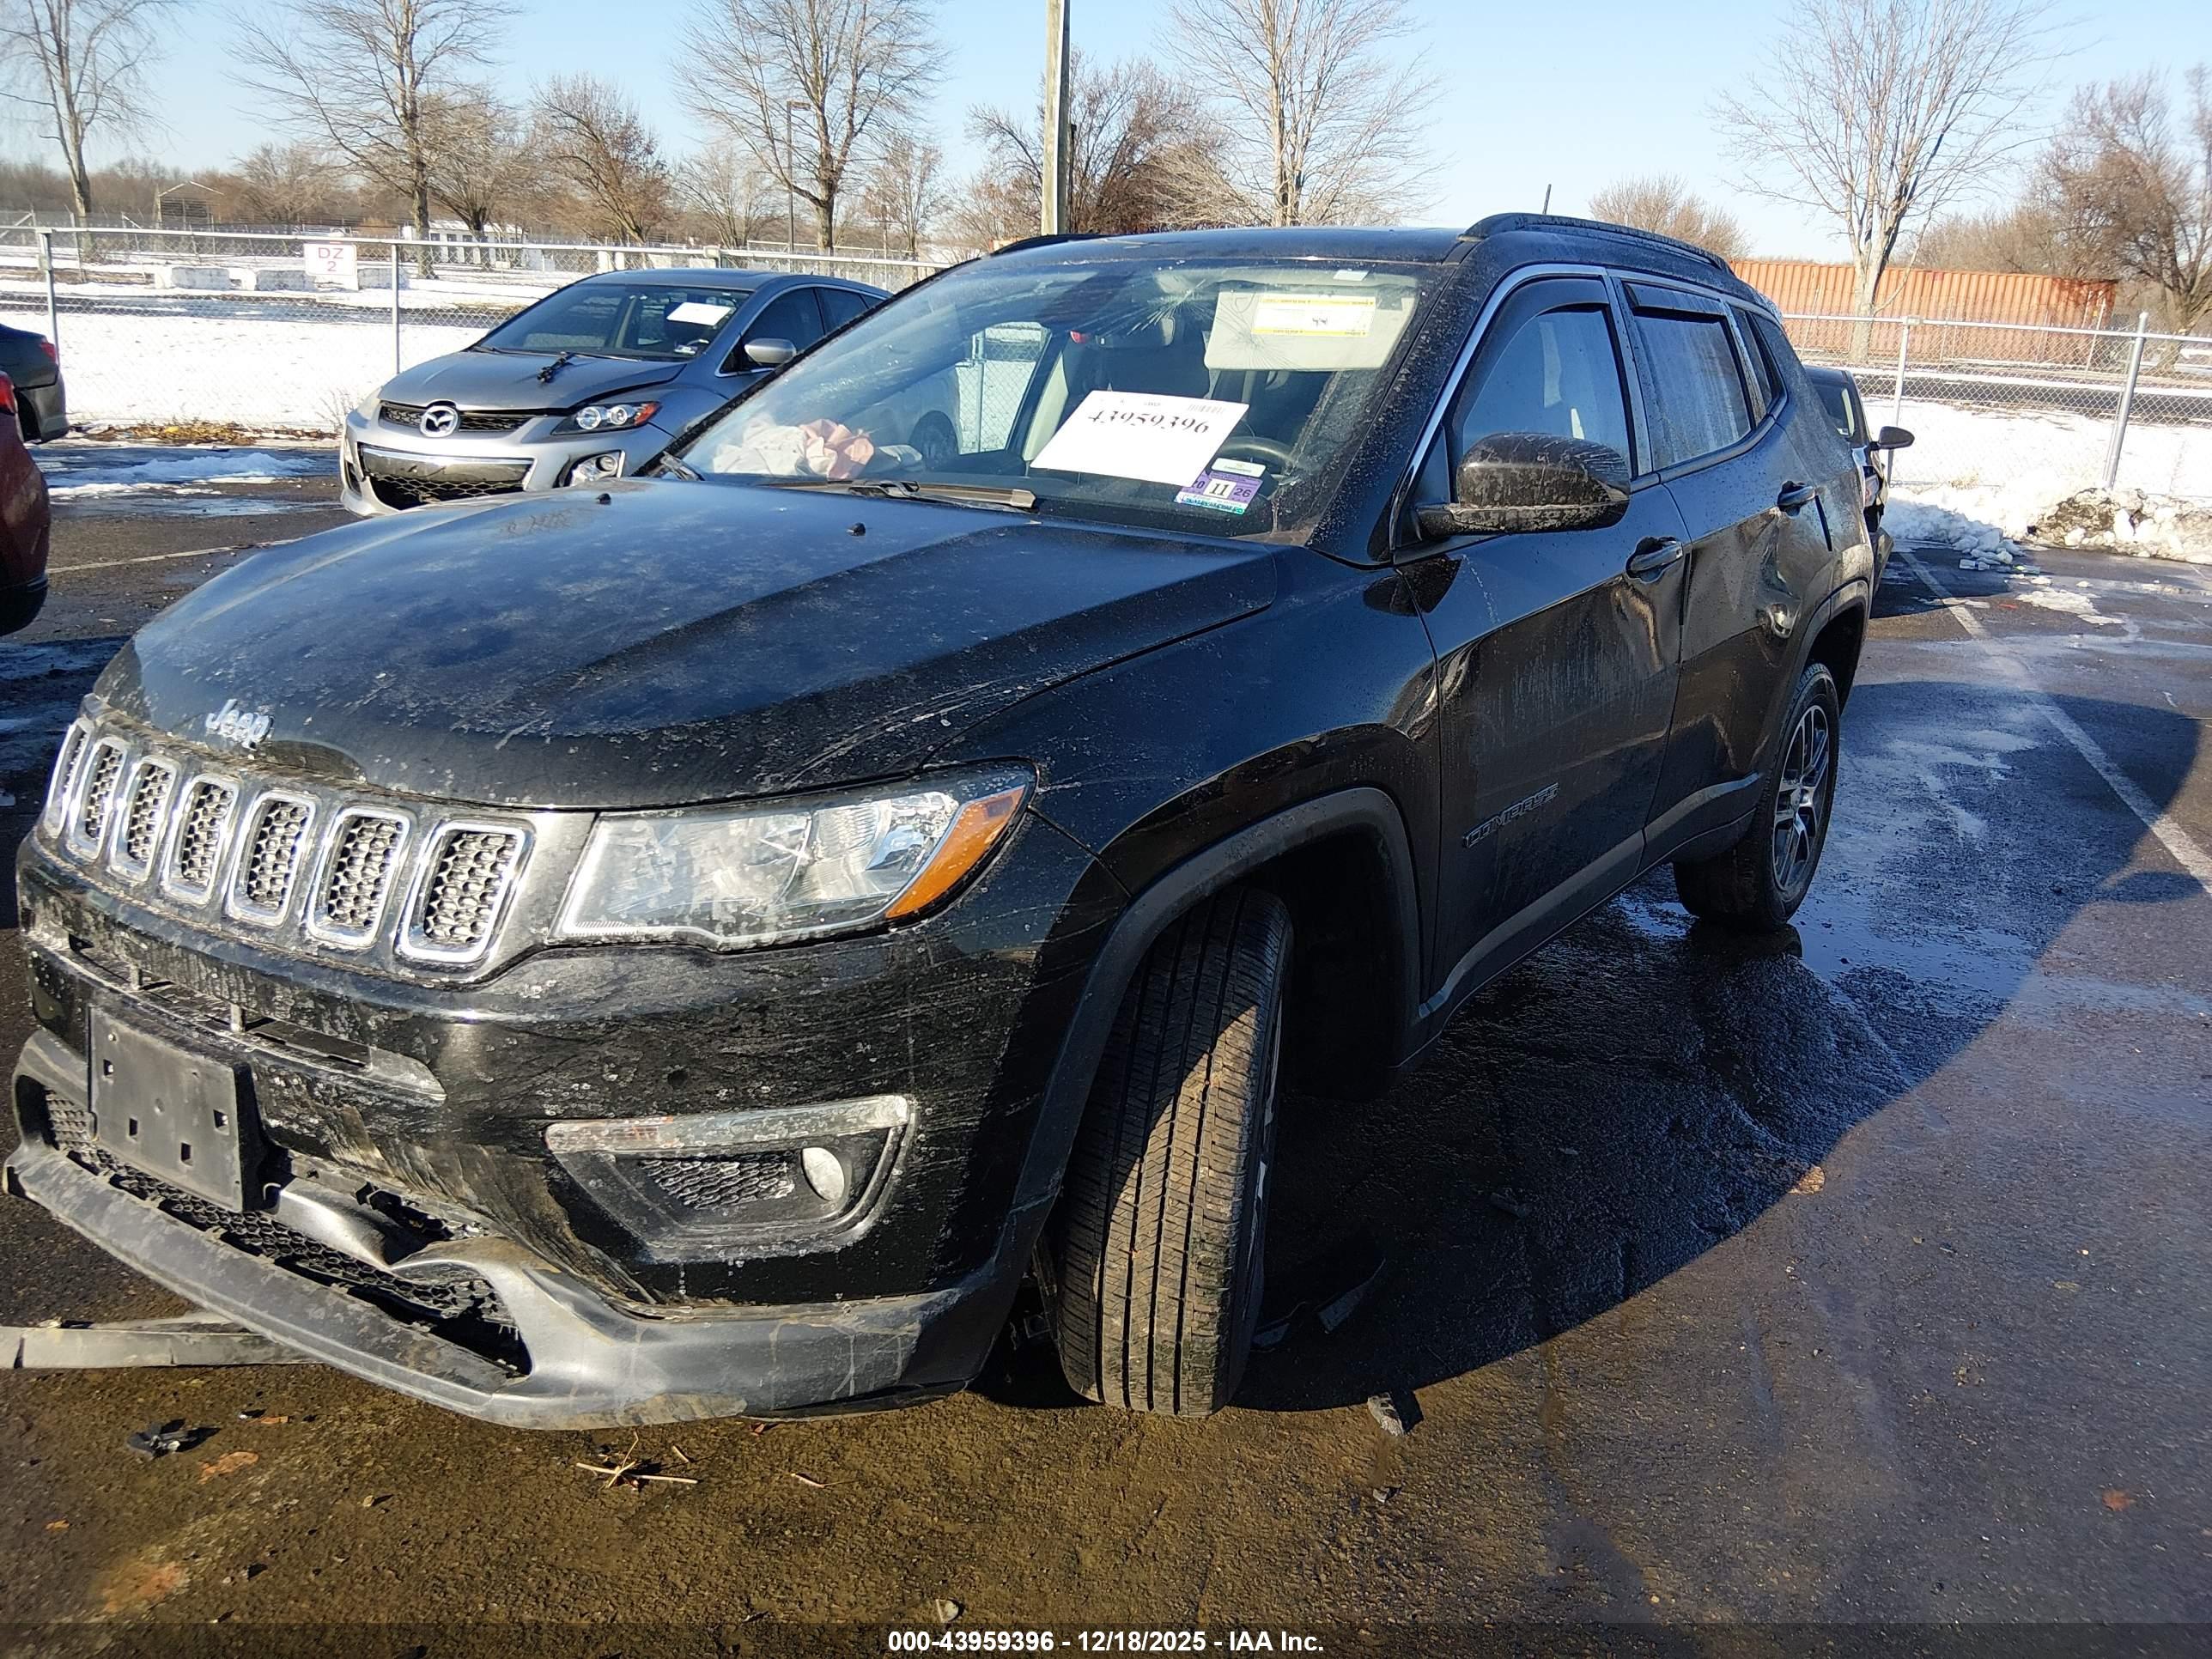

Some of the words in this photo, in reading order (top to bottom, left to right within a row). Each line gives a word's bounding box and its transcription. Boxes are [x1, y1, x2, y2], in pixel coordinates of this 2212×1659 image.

[319, 247, 344, 259] DZ
[327, 261, 337, 272] 2
[1087, 410, 1210, 434] 43959396
[1209, 483, 1230, 496] 11
[1233, 488, 1252, 498] 26
[205, 698, 274, 751] Jeep
[1462, 781, 1561, 848] COMPASS
